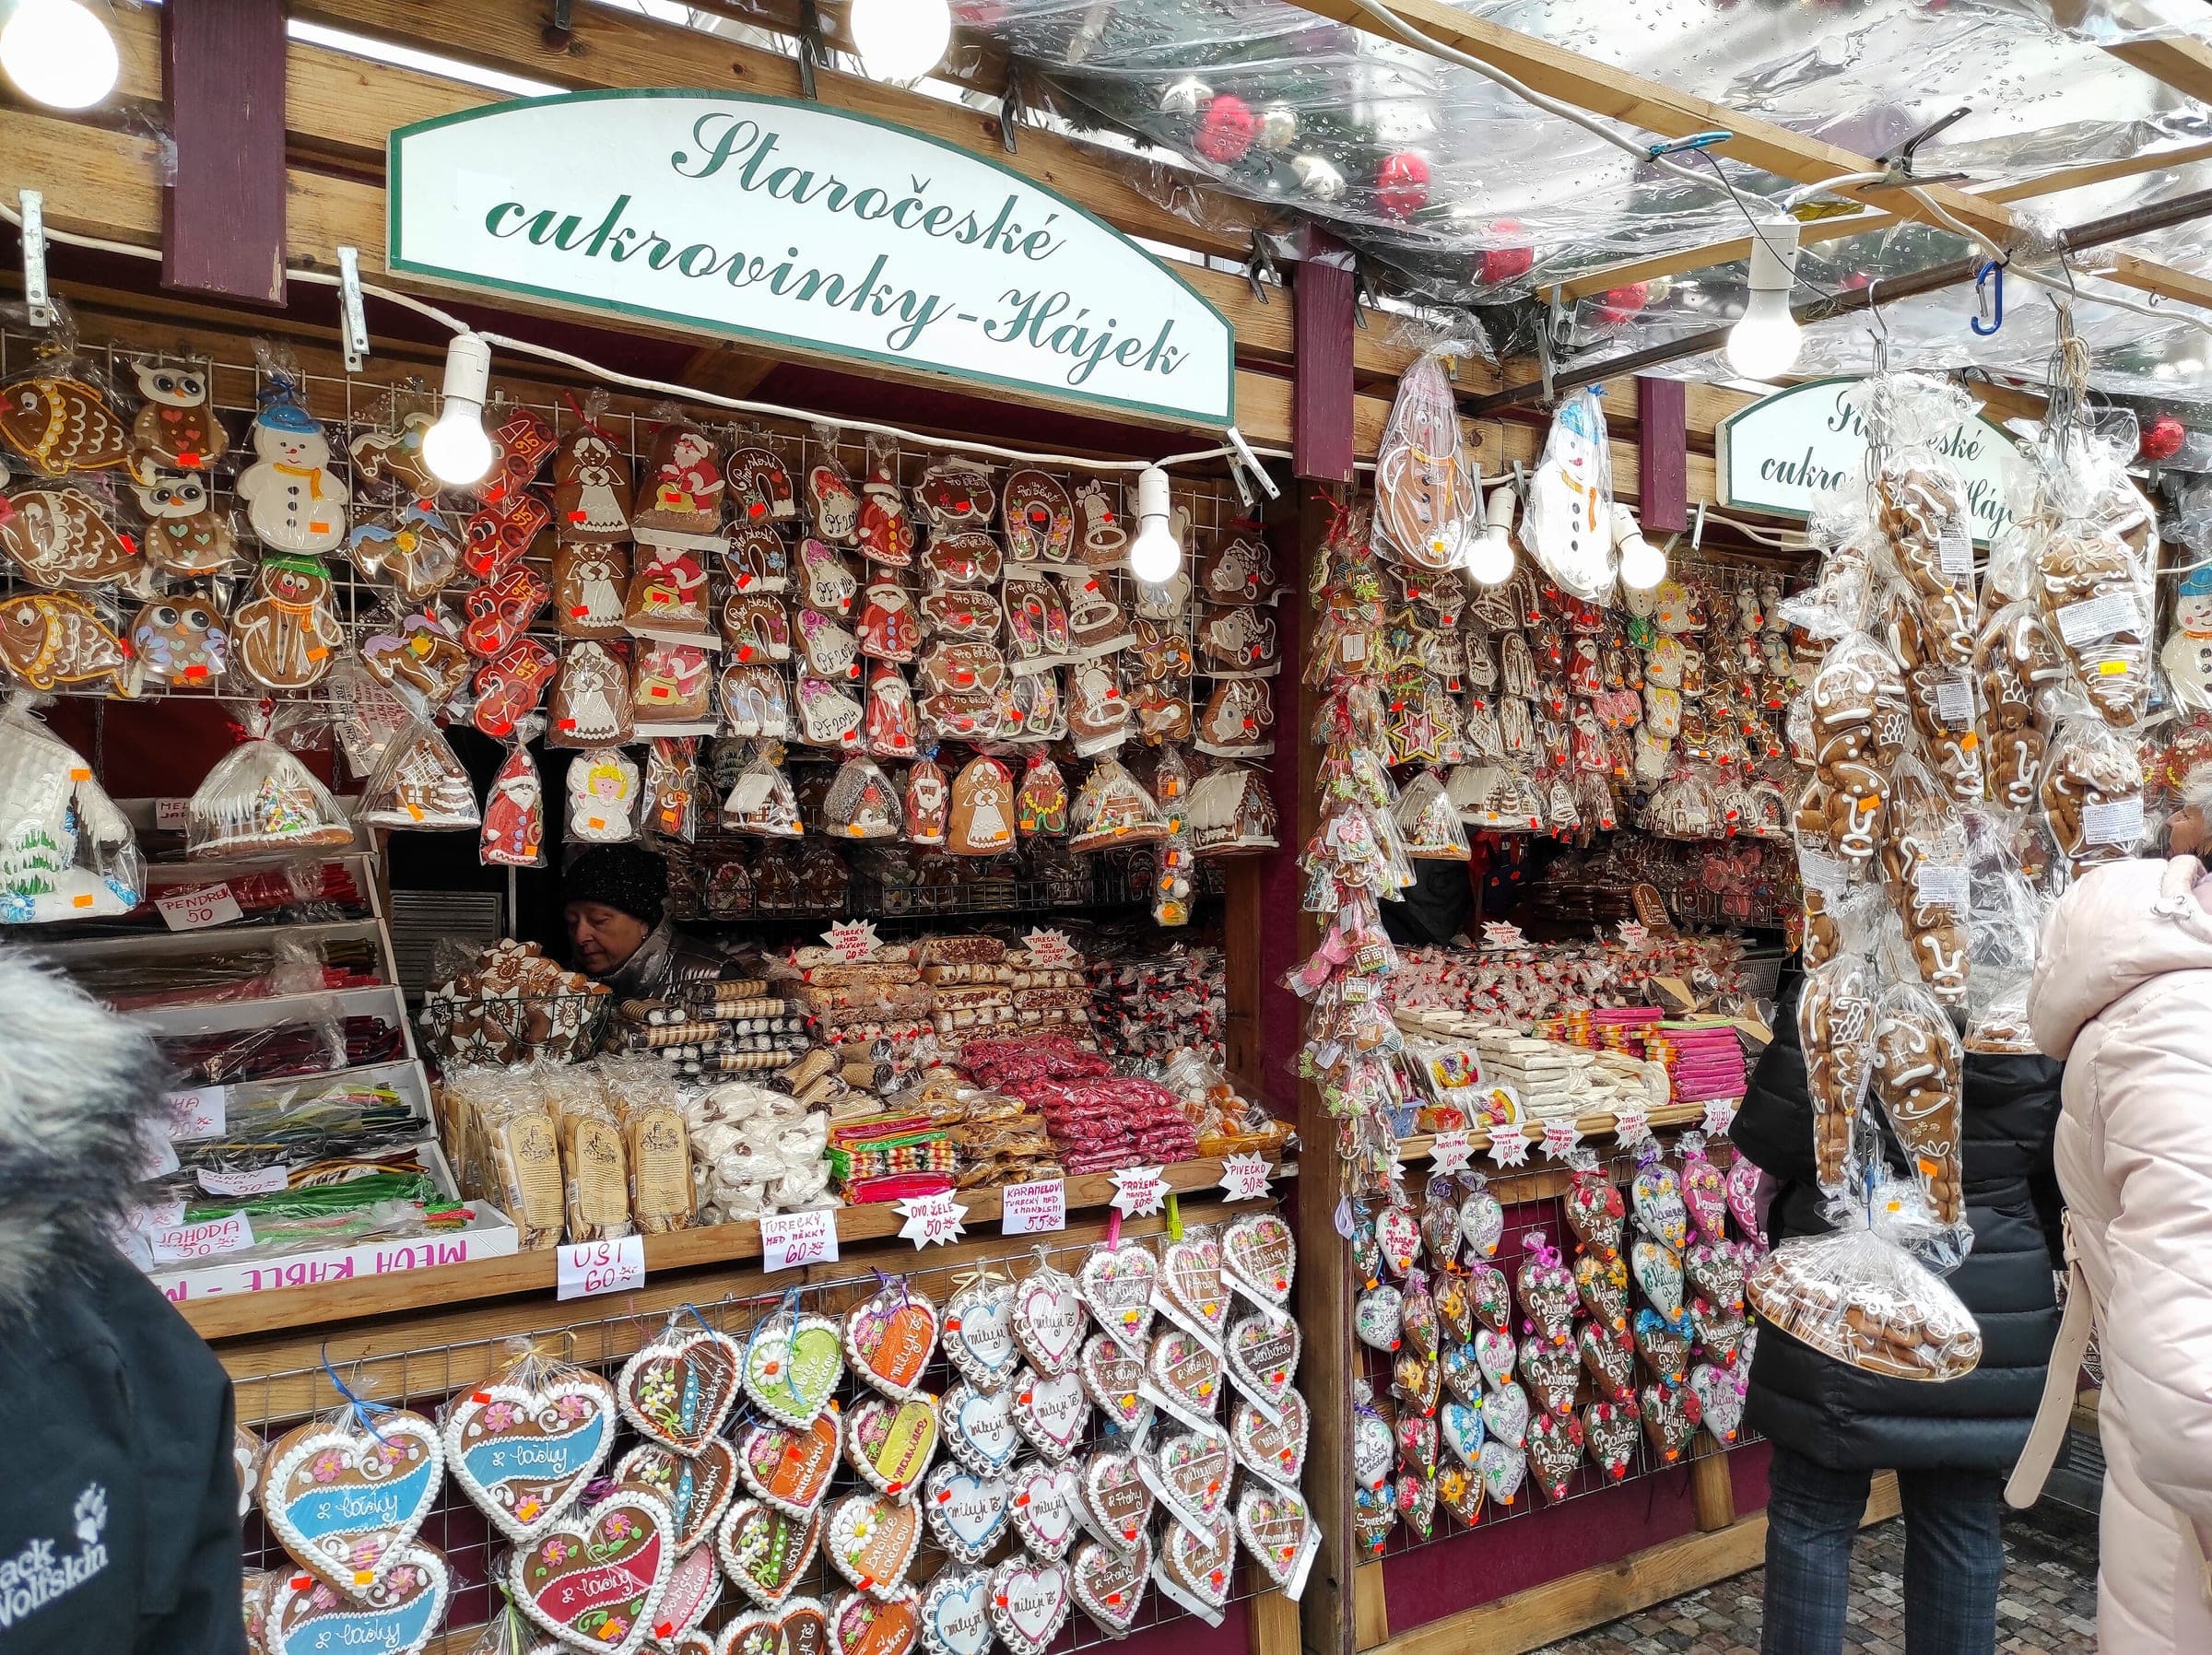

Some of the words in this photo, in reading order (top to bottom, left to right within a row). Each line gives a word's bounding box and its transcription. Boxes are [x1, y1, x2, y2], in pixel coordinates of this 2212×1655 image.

[671, 112, 1066, 261] Staročeské
[514, 430, 540, 454] 95
[512, 505, 533, 527] 95
[825, 514, 842, 534] PF
[511, 578, 533, 601] 95
[817, 581, 833, 603] PF
[515, 657, 538, 681] 95
[818, 653, 834, 672] PF
[813, 721, 831, 738] PF
[831, 709, 859, 733] 2024
[186, 909, 213, 922] 50
[845, 950, 856, 959] 60
[1042, 955, 1053, 964] 60
[1715, 1122, 1724, 1132] 60
[1502, 1145, 1513, 1159] 60
[1551, 1142, 1563, 1154] 60
[1230, 1161, 1265, 1175] PIVEČKO
[1446, 1155, 1457, 1167] 60
[233, 1182, 263, 1193] 50
[1240, 1177, 1256, 1194] 30
[911, 1206, 930, 1218] OVO.
[1133, 1199, 1145, 1209] 80
[157, 1219, 240, 1245] JAHODA
[924, 1219, 942, 1238] 50
[1024, 1215, 1049, 1230] 55
[177, 1244, 211, 1257] 50
[766, 1236, 785, 1246] MED
[785, 1242, 806, 1263] 60
[584, 1268, 616, 1293] 60
[1033, 1314, 1063, 1336] miluji
[968, 1323, 1006, 1349] miluji
[1037, 1395, 1066, 1419] miluji
[969, 1415, 1004, 1441] miluji
[509, 1442, 570, 1473] lásky
[1179, 1463, 1214, 1484] miluji
[1032, 1495, 1063, 1519] miluji
[1117, 1489, 1143, 1508] Prahy
[947, 1500, 989, 1523] miluji
[0, 1539, 55, 1589] ack
[575, 1567, 635, 1602] lásky
[1103, 1566, 1135, 1585] Prahy
[1014, 1596, 1045, 1618] miluji
[943, 1611, 983, 1637] miluji
